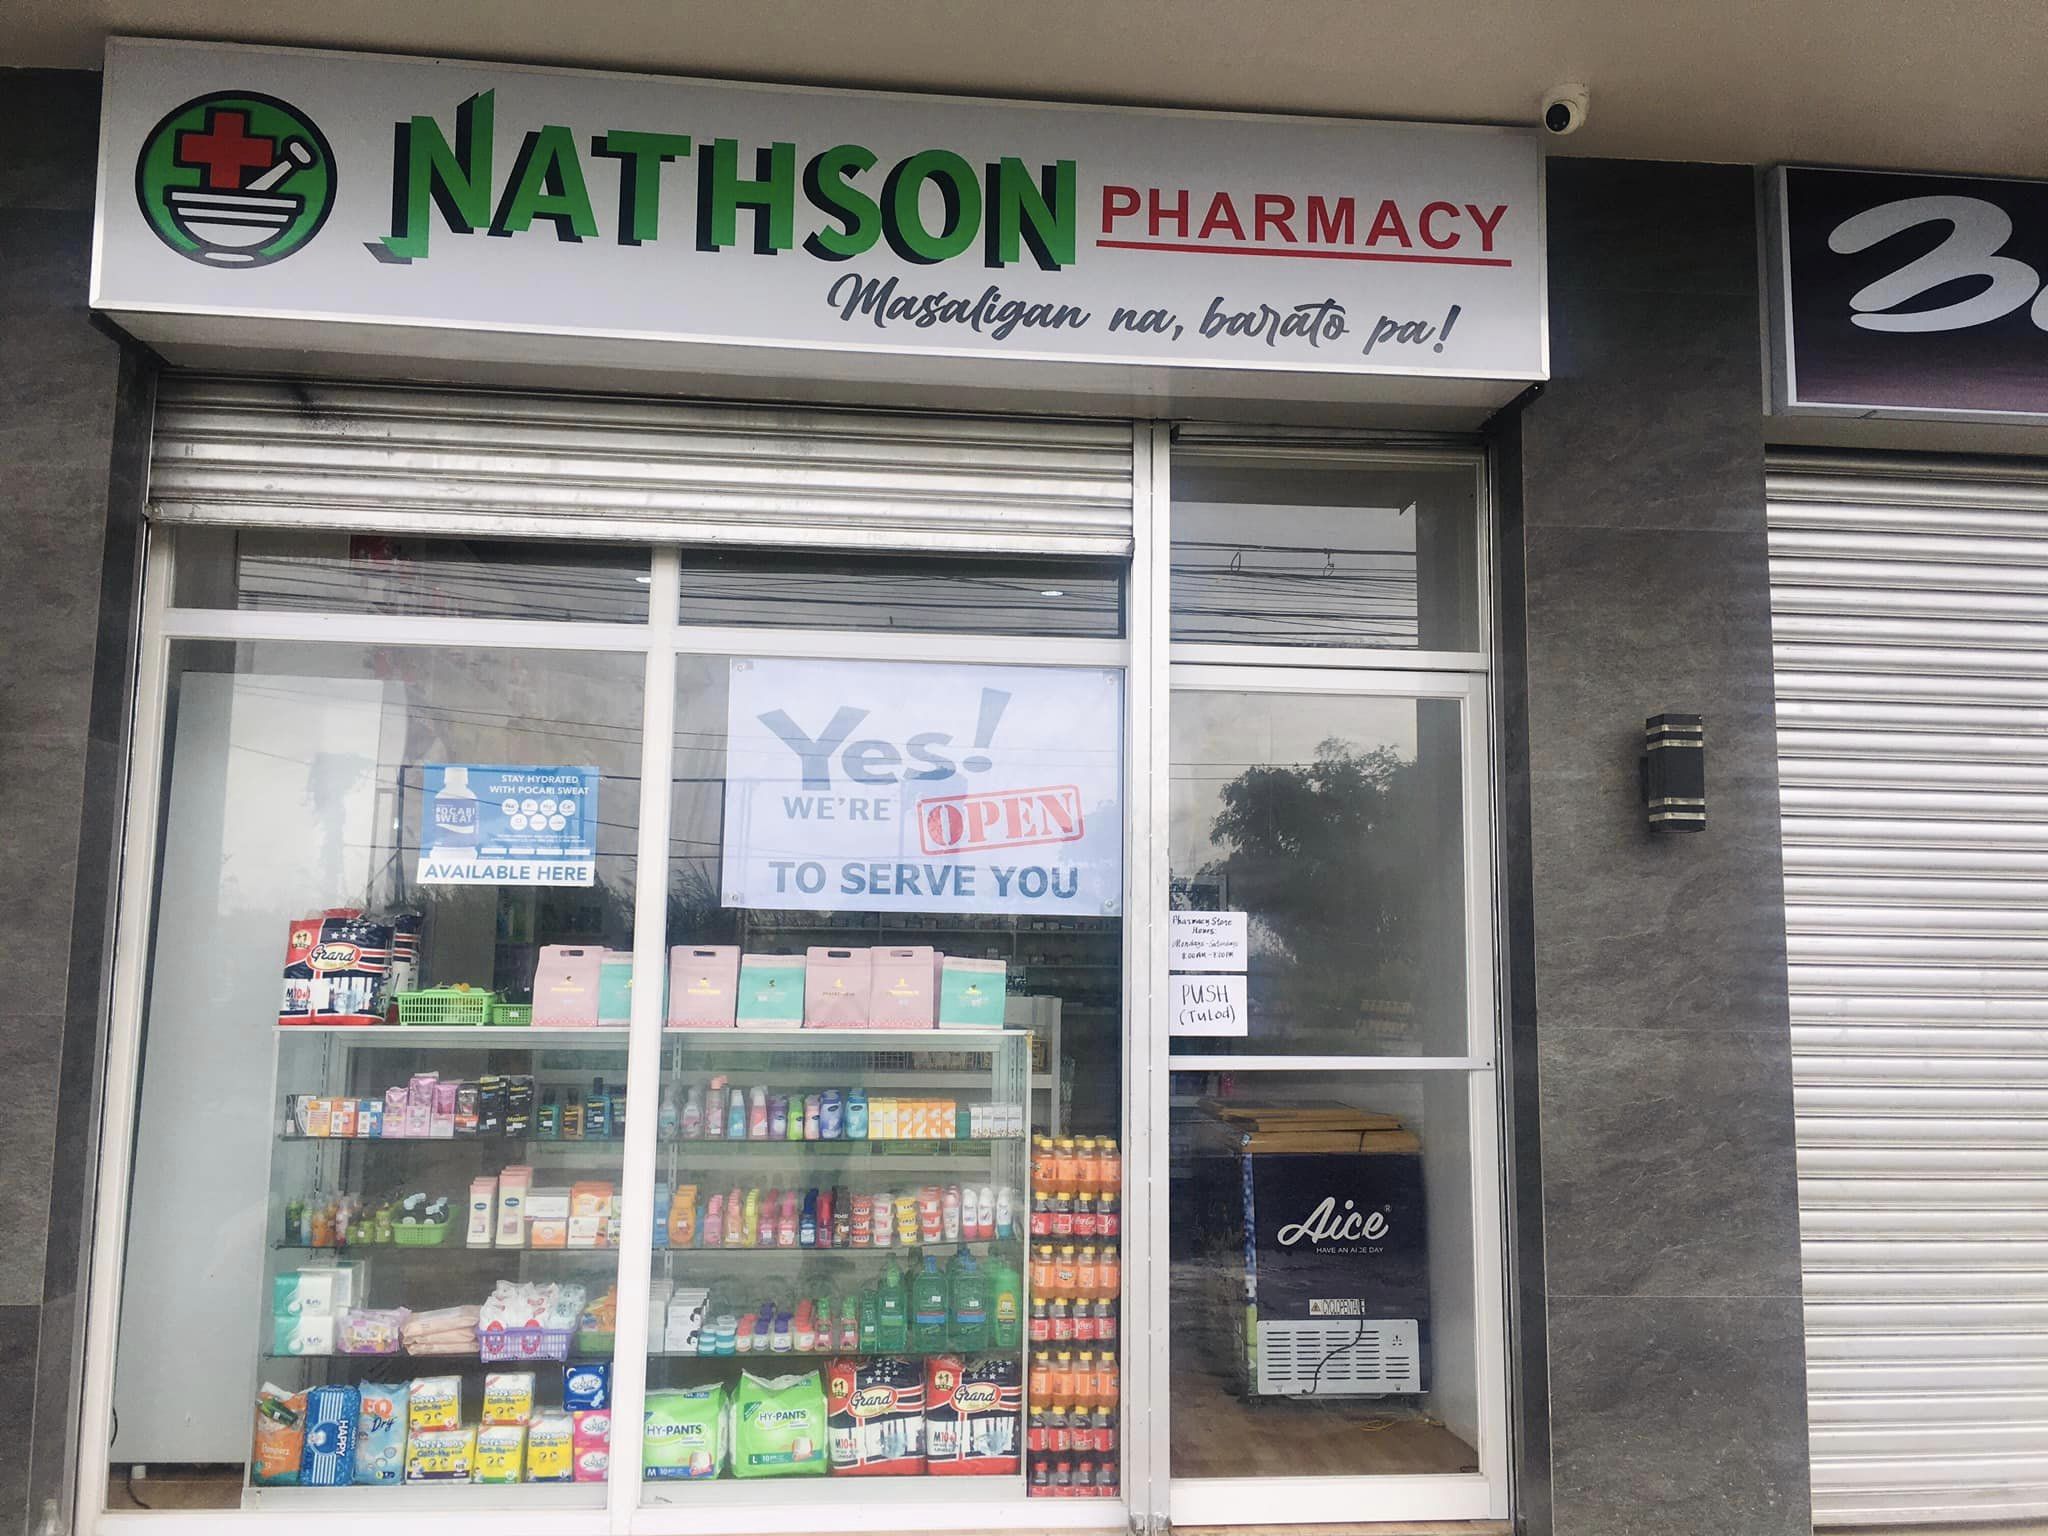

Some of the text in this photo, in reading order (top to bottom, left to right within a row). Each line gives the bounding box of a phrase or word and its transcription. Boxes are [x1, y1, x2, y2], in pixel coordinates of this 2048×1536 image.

[365, 88, 1508, 271] NATHSON PHARMACY
[827, 272, 1462, 355] Masaligan na, barato pa!
[756, 687, 1013, 792] Yes!
[501, 775, 579, 784] STAY HYDRATED
[489, 785, 590, 796] WITH POCARI SWEAT
[435, 806, 476, 816] POCARI
[435, 813, 472, 823] SWEAT
[783, 792, 1074, 847] WE'RE OPEN
[424, 864, 588, 881] AVAILABLE HERE
[768, 861, 1079, 899] TO SERVE YOU
[310, 943, 356, 963] Grand
[1182, 984, 1229, 1005] PUSH
[1277, 1197, 1389, 1246] Aice
[850, 1390, 892, 1409] Grand
[954, 1385, 995, 1404] Grand
[372, 1415, 396, 1433] Dry
[759, 1410, 807, 1422] HY-PANTS
[336, 1420, 349, 1457] HAPPY
[647, 1424, 702, 1436] HY-PANTS
[752, 1456, 758, 1464] L
[647, 1468, 657, 1477] M
